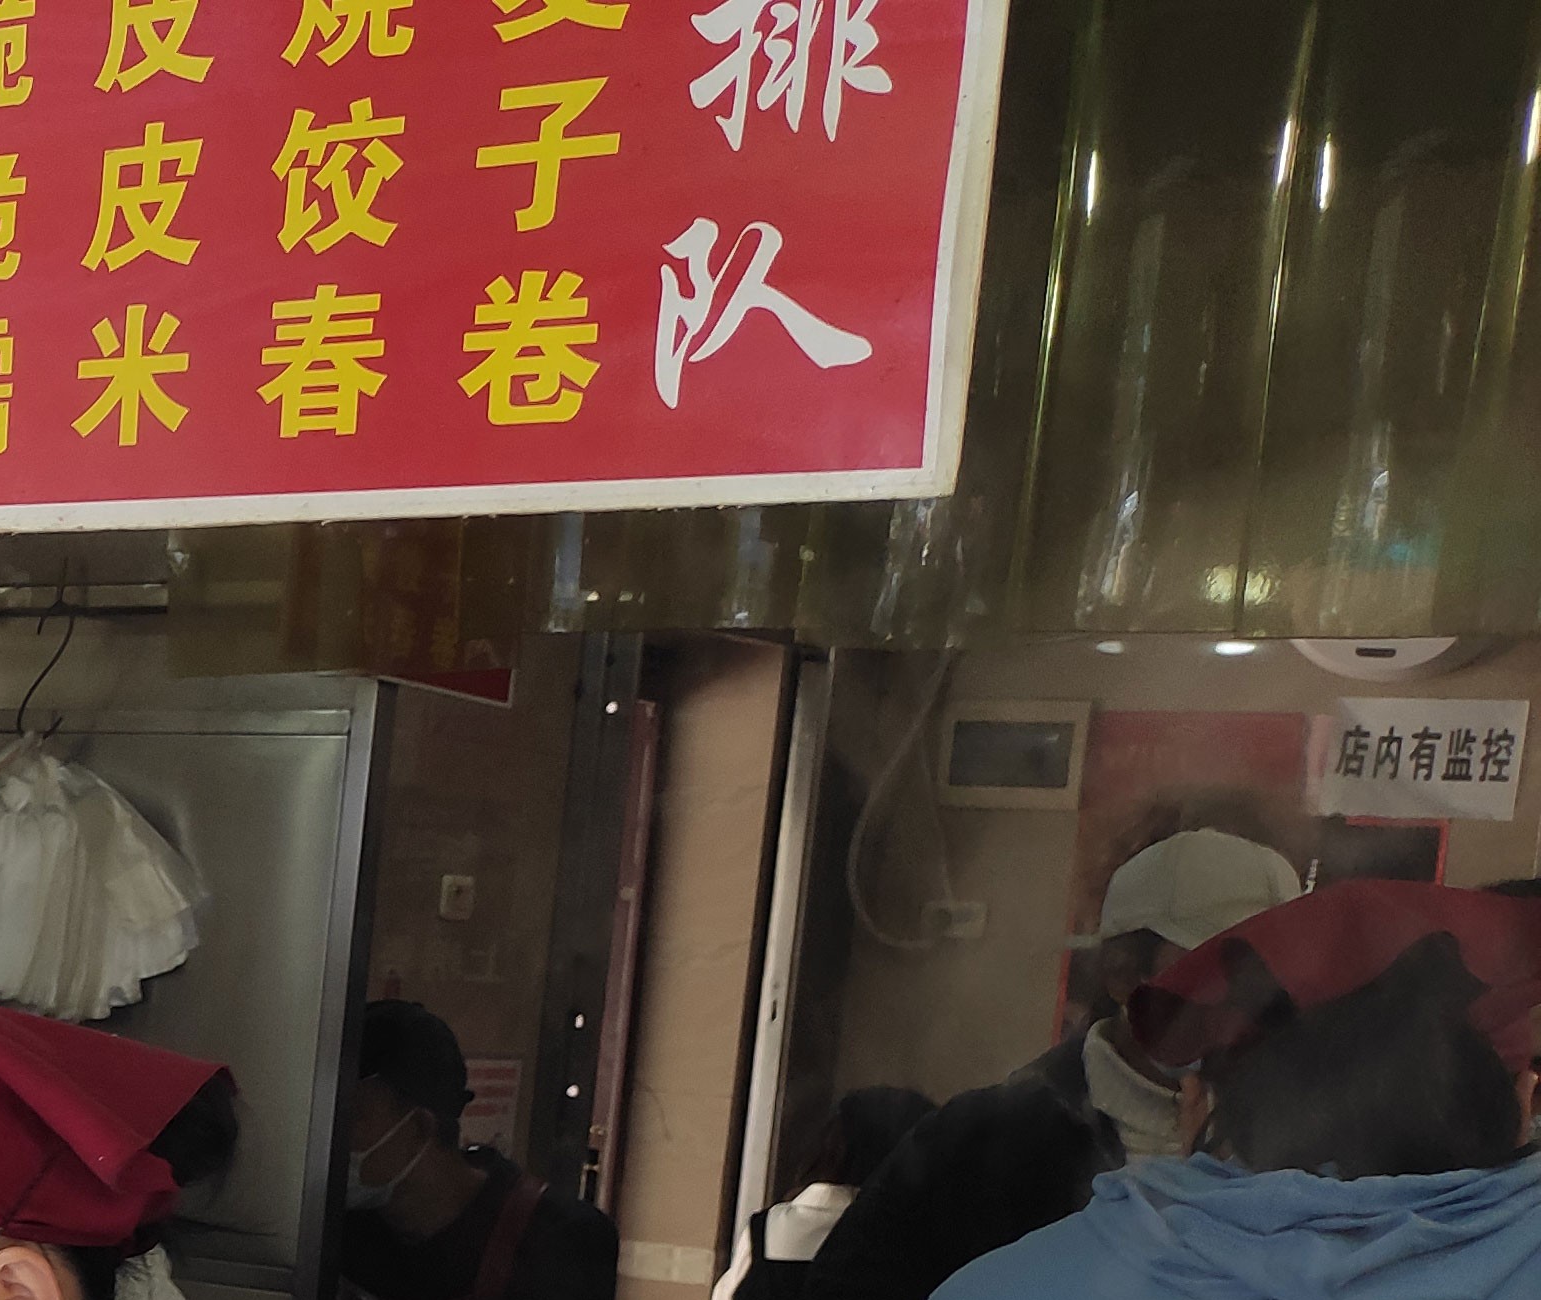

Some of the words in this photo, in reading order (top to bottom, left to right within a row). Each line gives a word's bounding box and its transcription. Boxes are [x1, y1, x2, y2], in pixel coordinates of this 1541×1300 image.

[1334, 724, 1516, 782] 店内有监控
